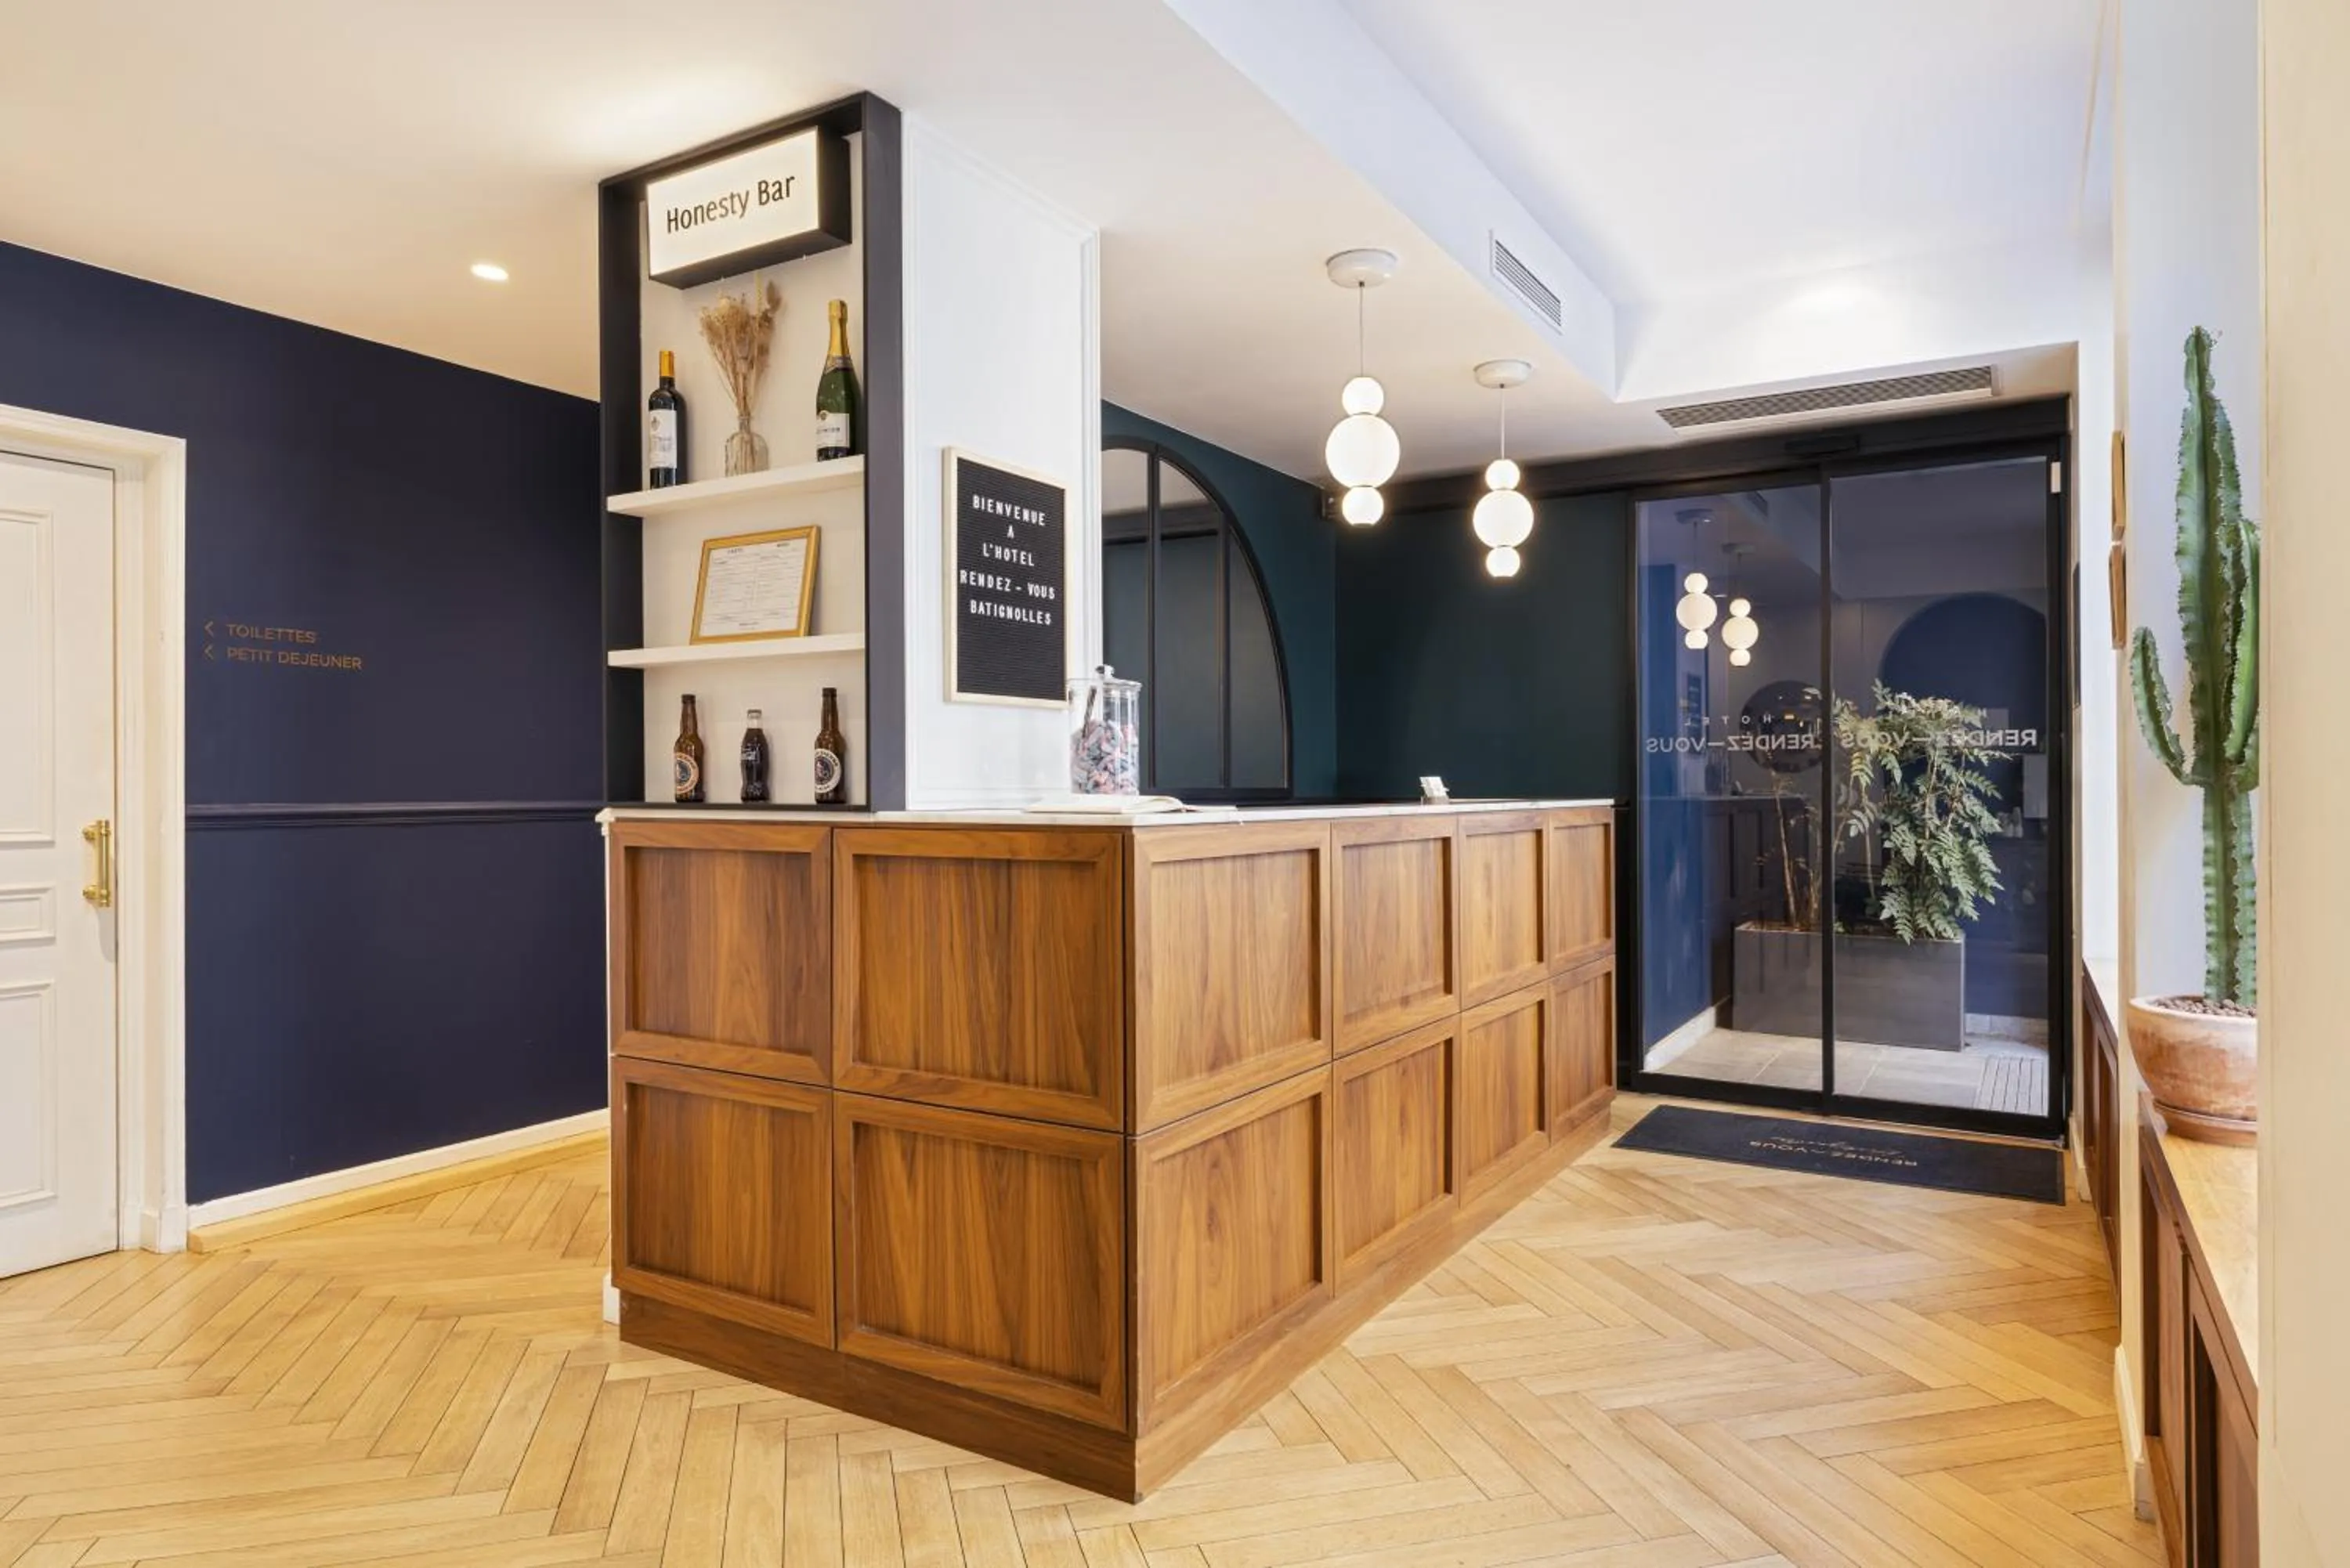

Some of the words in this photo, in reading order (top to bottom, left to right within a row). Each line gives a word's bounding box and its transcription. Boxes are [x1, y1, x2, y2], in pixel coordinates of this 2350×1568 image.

[667, 190, 750, 233] Honesty
[757, 175, 795, 206] Bar
[973, 494, 1046, 526] BIENVENUE
[1007, 525, 1014, 538] A
[983, 543, 1034, 566] L'HOTEL
[970, 599, 1051, 625] BATIGNOLLES
[226, 624, 316, 643] TOILETTES
[227, 647, 273, 663] PETIT
[278, 652, 363, 670] DEJEUNER
